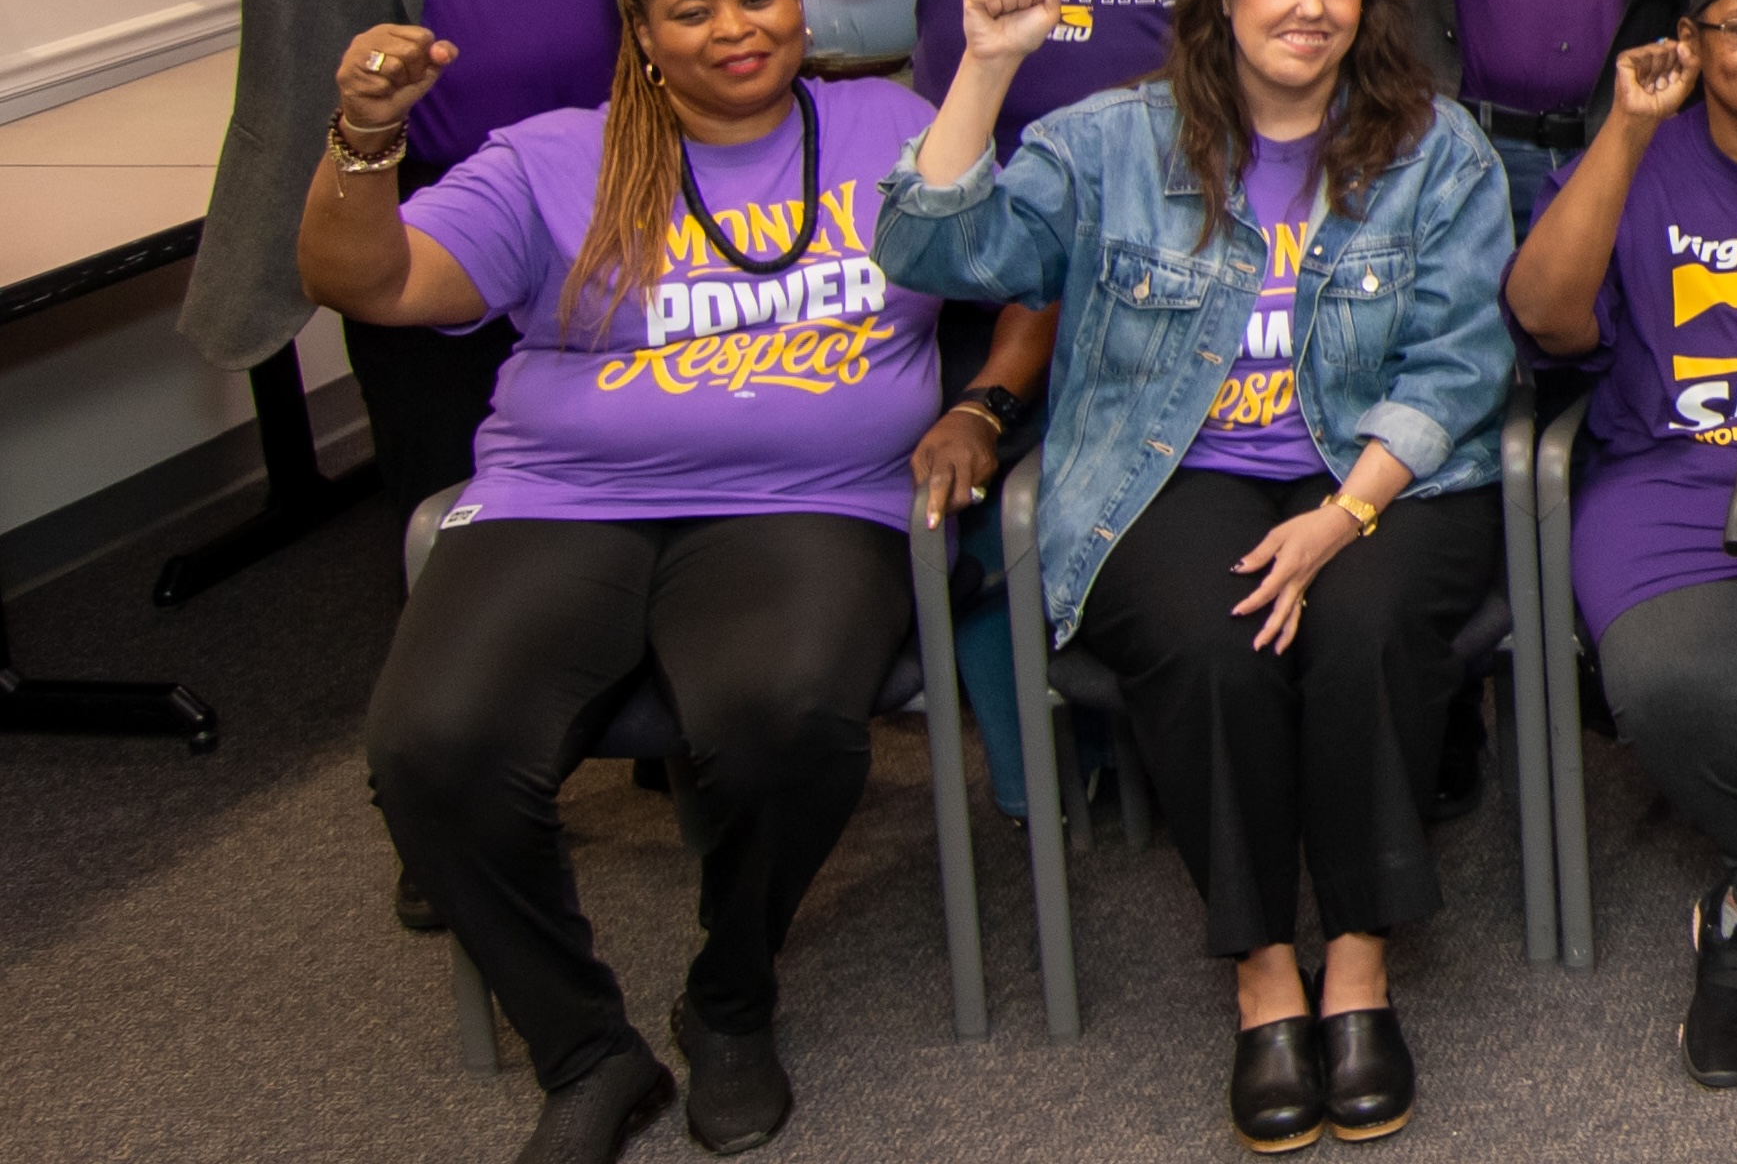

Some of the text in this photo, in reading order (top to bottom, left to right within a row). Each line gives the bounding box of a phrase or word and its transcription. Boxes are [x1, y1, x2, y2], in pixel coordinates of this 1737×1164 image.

[1052, 23, 1092, 42] EIU
[638, 179, 867, 274] MONEY
[646, 257, 886, 346] POWER
[597, 316, 895, 395] Respect
